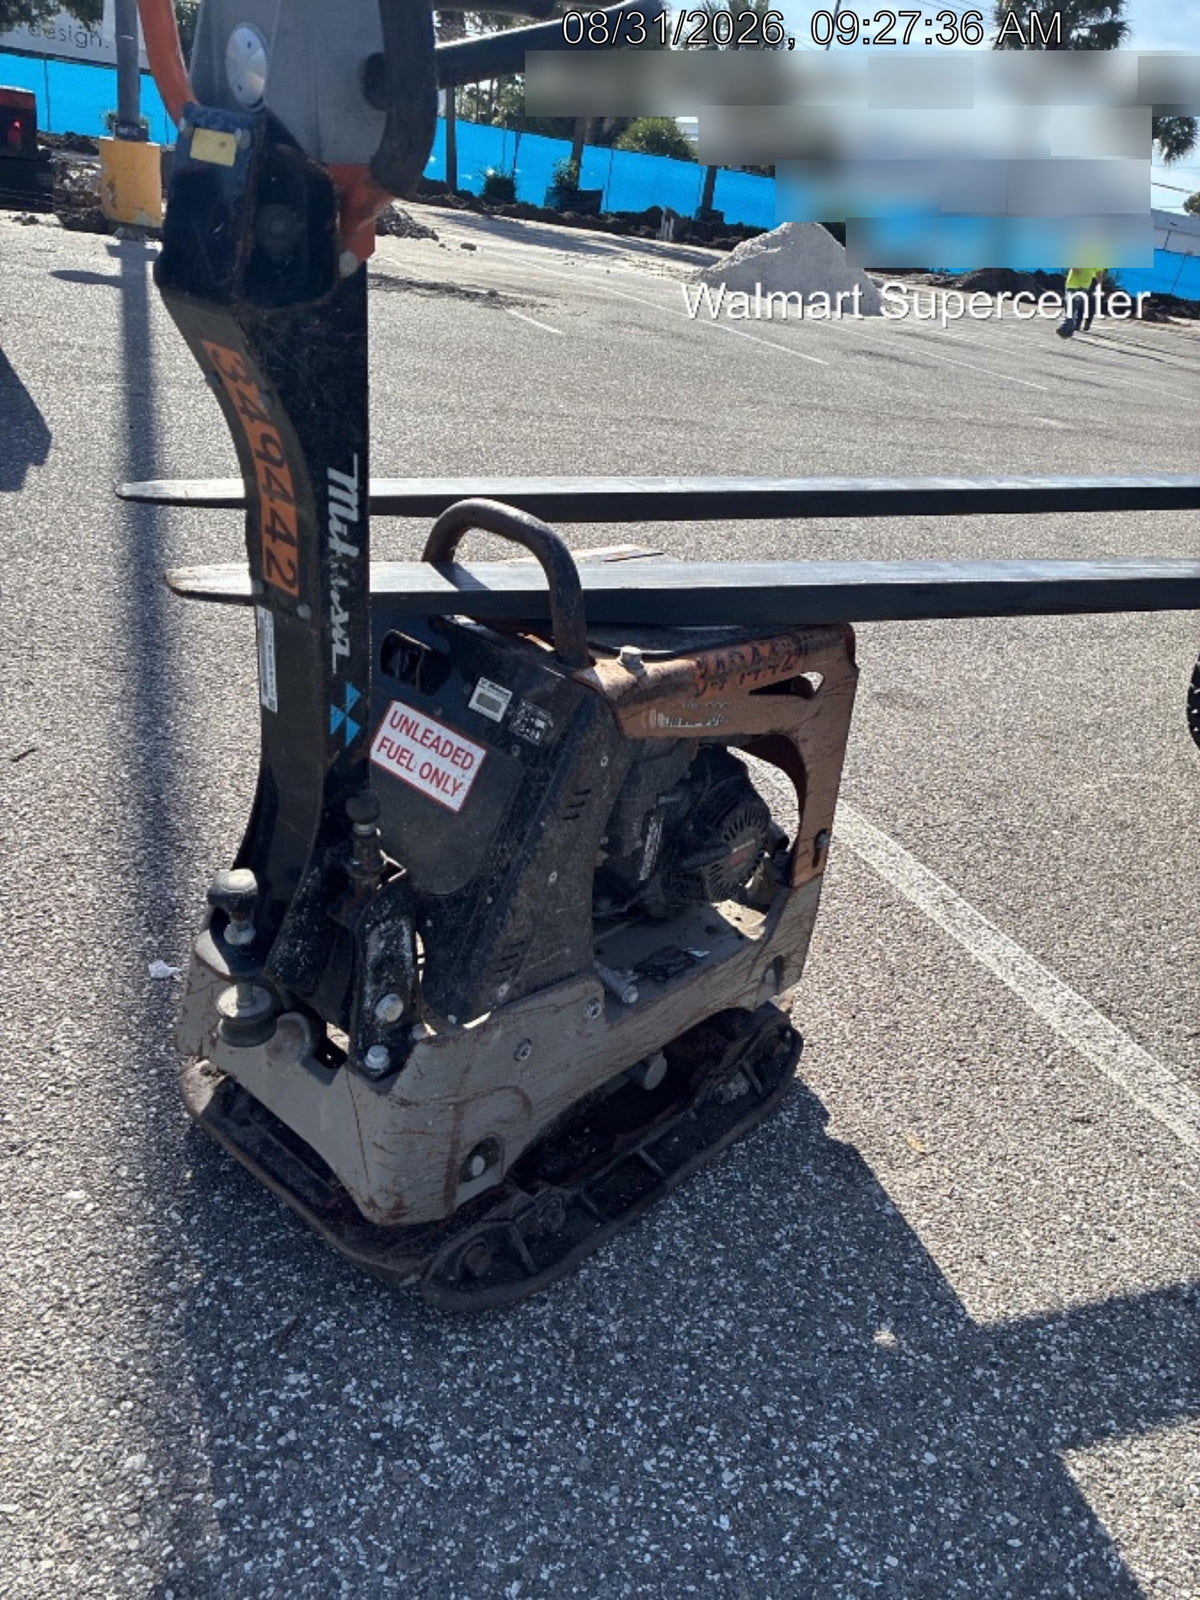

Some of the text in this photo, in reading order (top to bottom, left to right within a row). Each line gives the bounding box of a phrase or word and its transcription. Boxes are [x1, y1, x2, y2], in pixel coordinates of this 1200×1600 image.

[211, 347, 298, 590] 349442
[376, 736, 464, 797] FUEL ONLY
[389, 709, 475, 771] UNLEADED
